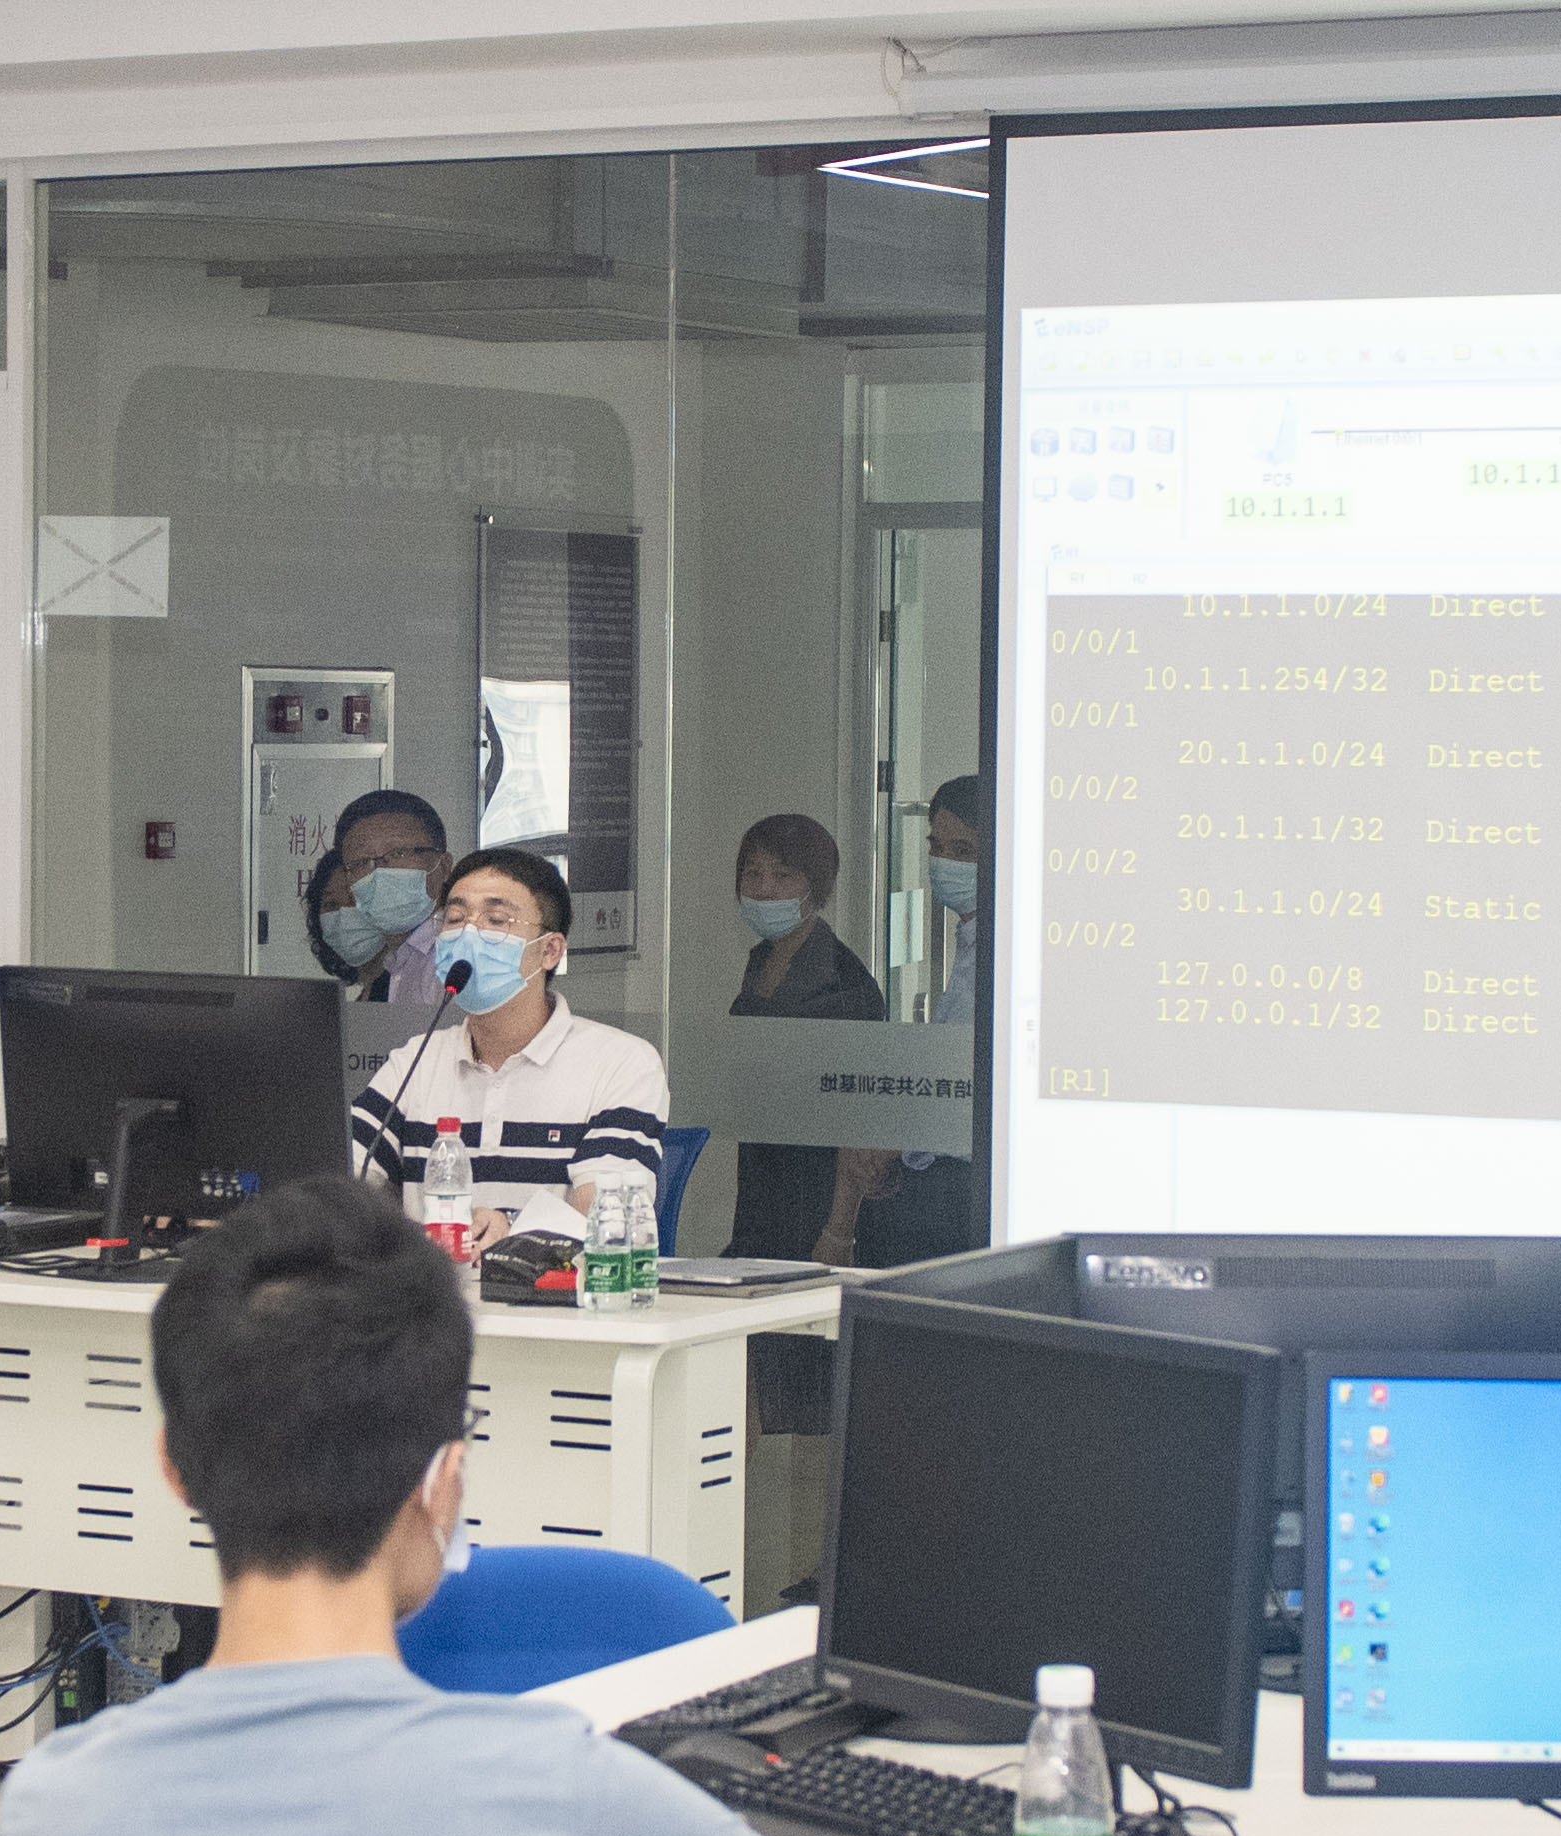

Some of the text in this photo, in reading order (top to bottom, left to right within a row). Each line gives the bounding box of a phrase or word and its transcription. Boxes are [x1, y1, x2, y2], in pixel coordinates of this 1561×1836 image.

[1226, 496, 1347, 519] 10.1.1.1
[1183, 593, 1387, 619] 10.1.1.0/24
[1430, 593, 1544, 618] Direct
[1051, 628, 1139, 656] 0/0/1
[1144, 665, 1388, 693] 10.1.1.254/32
[1428, 667, 1544, 694] Direct
[1050, 700, 1139, 728] 0/0/1
[1178, 739, 1384, 768] 20.1.1.0/24
[1428, 743, 1543, 769] Direct
[1049, 773, 1139, 801] 0/0/2
[289, 814, 340, 856] 消火
[1176, 813, 1384, 844] 20.1.1.1/32
[1425, 817, 1543, 846] Direct
[1047, 847, 1138, 875] 0/0/2
[1176, 887, 1382, 919] 30.1.1.0/24
[1423, 893, 1542, 921] Static
[1047, 920, 1136, 949] 0/0/2
[1158, 960, 1363, 992] 127.0.0.0/8
[1423, 968, 1539, 998] Direct
[1158, 996, 1381, 1030] 127.0.0.1/32
[1423, 1007, 1540, 1035] Direct
[1049, 1066, 1110, 1098] [R1]
